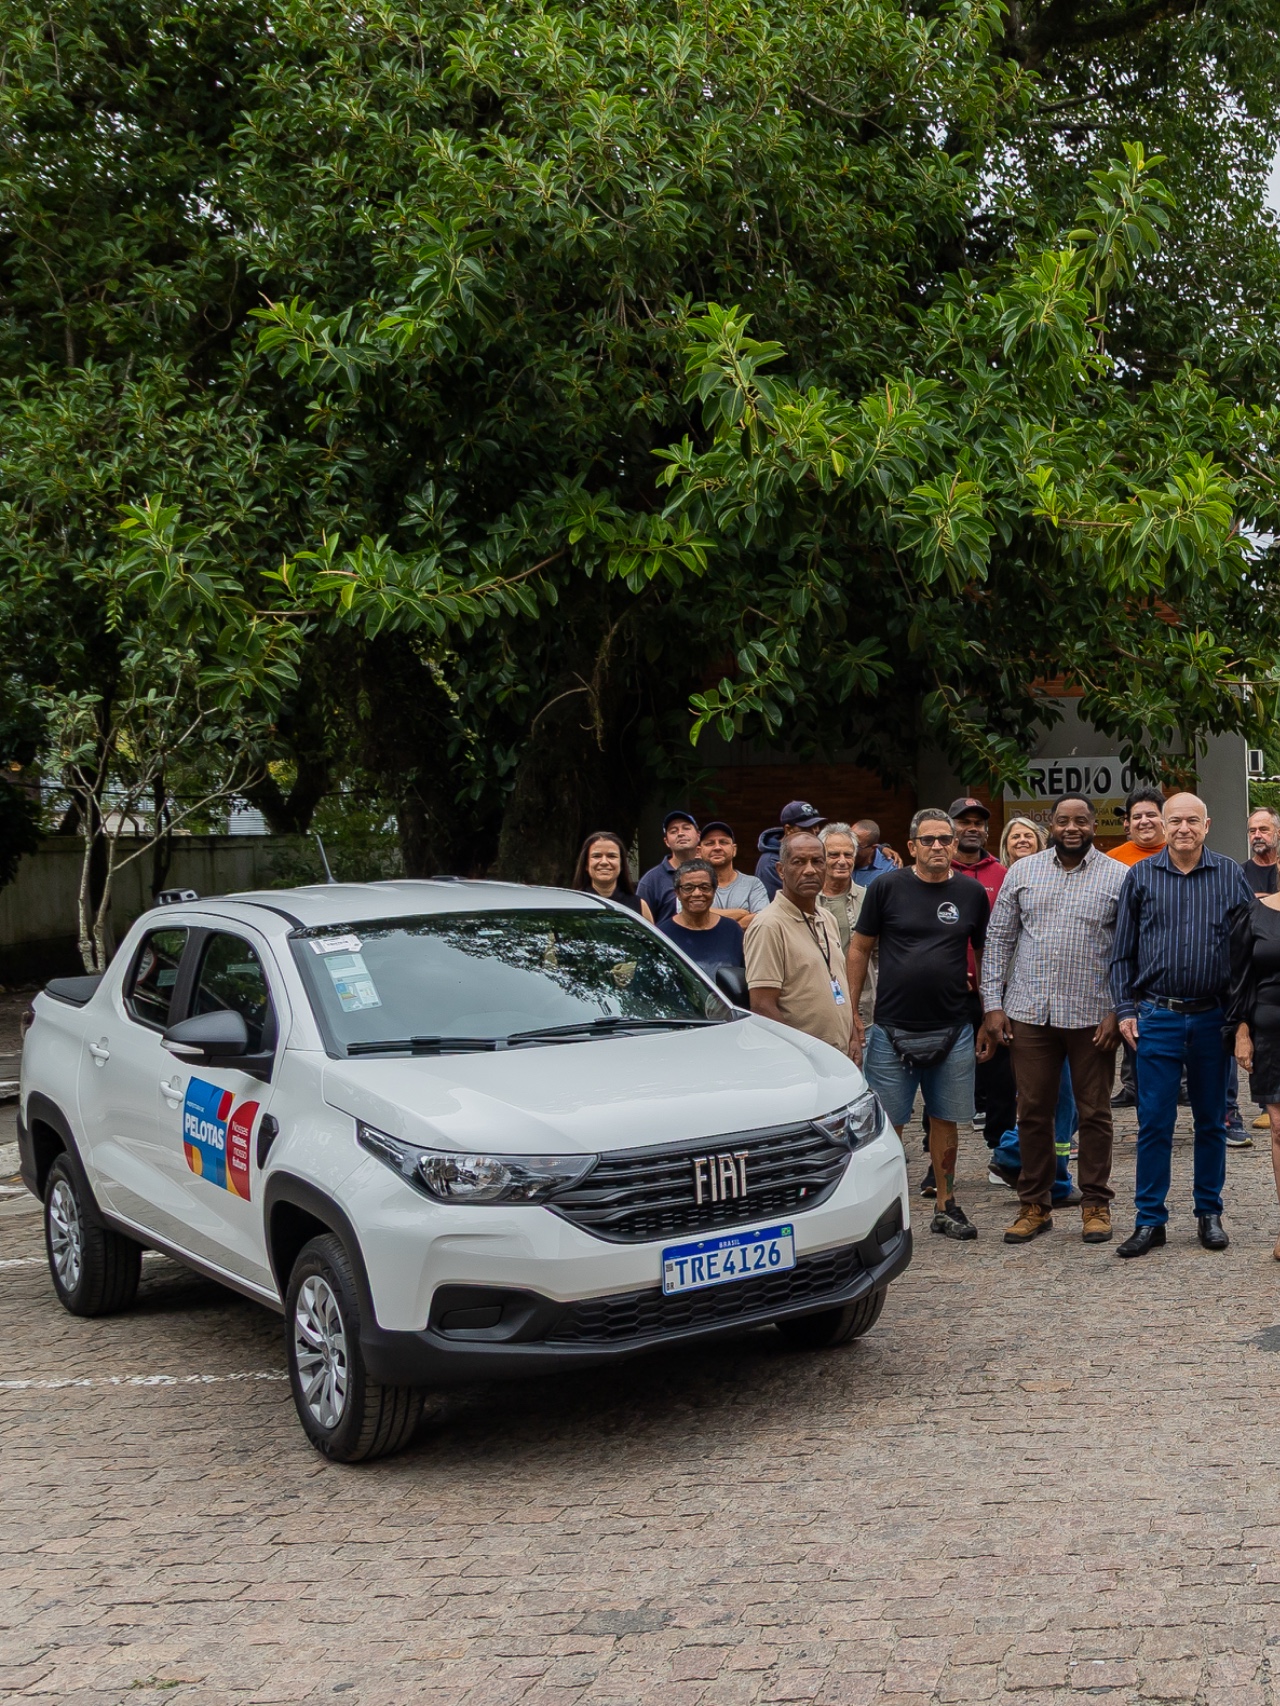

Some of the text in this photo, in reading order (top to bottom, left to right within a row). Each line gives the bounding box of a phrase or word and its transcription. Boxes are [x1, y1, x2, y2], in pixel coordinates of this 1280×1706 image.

[1018, 761, 1111, 795] RÉDIO
[184, 1112, 225, 1151] PELOTAS
[692, 1150, 749, 1205] FIAT
[718, 1238, 741, 1249] BRASIL
